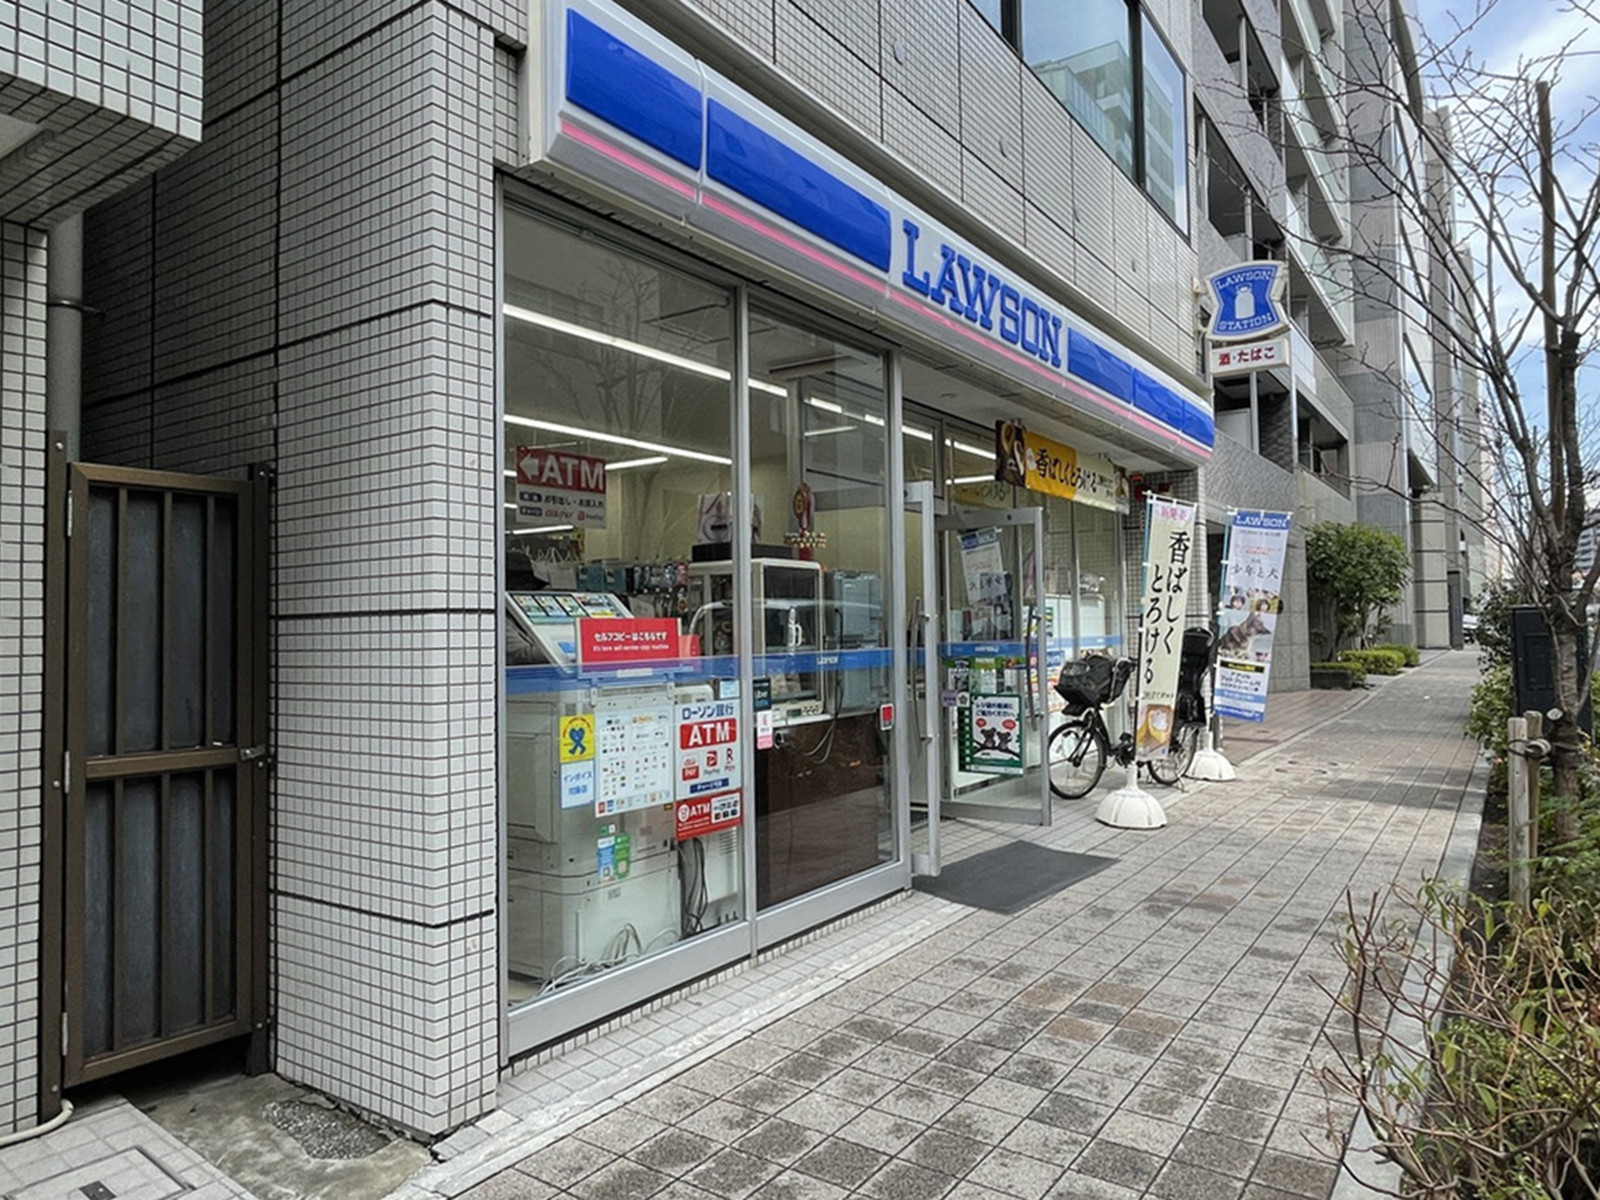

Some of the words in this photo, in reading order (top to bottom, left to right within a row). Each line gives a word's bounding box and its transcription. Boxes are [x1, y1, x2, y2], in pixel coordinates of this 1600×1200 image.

[1216, 270, 1272, 290] LAWSON
[902, 219, 1062, 368] LAWSON
[1219, 312, 1273, 331] STATION
[541, 454, 604, 491] ATM
[1236, 515, 1287, 527] LAWSON
[1230, 564, 1279, 580] 少年と犬
[1163, 531, 1190, 655] 香ばしく
[1144, 564, 1164, 685] とろける
[681, 703, 734, 720] ローソン銀行
[688, 721, 730, 747] ATM
[690, 802, 710, 817] ATM
